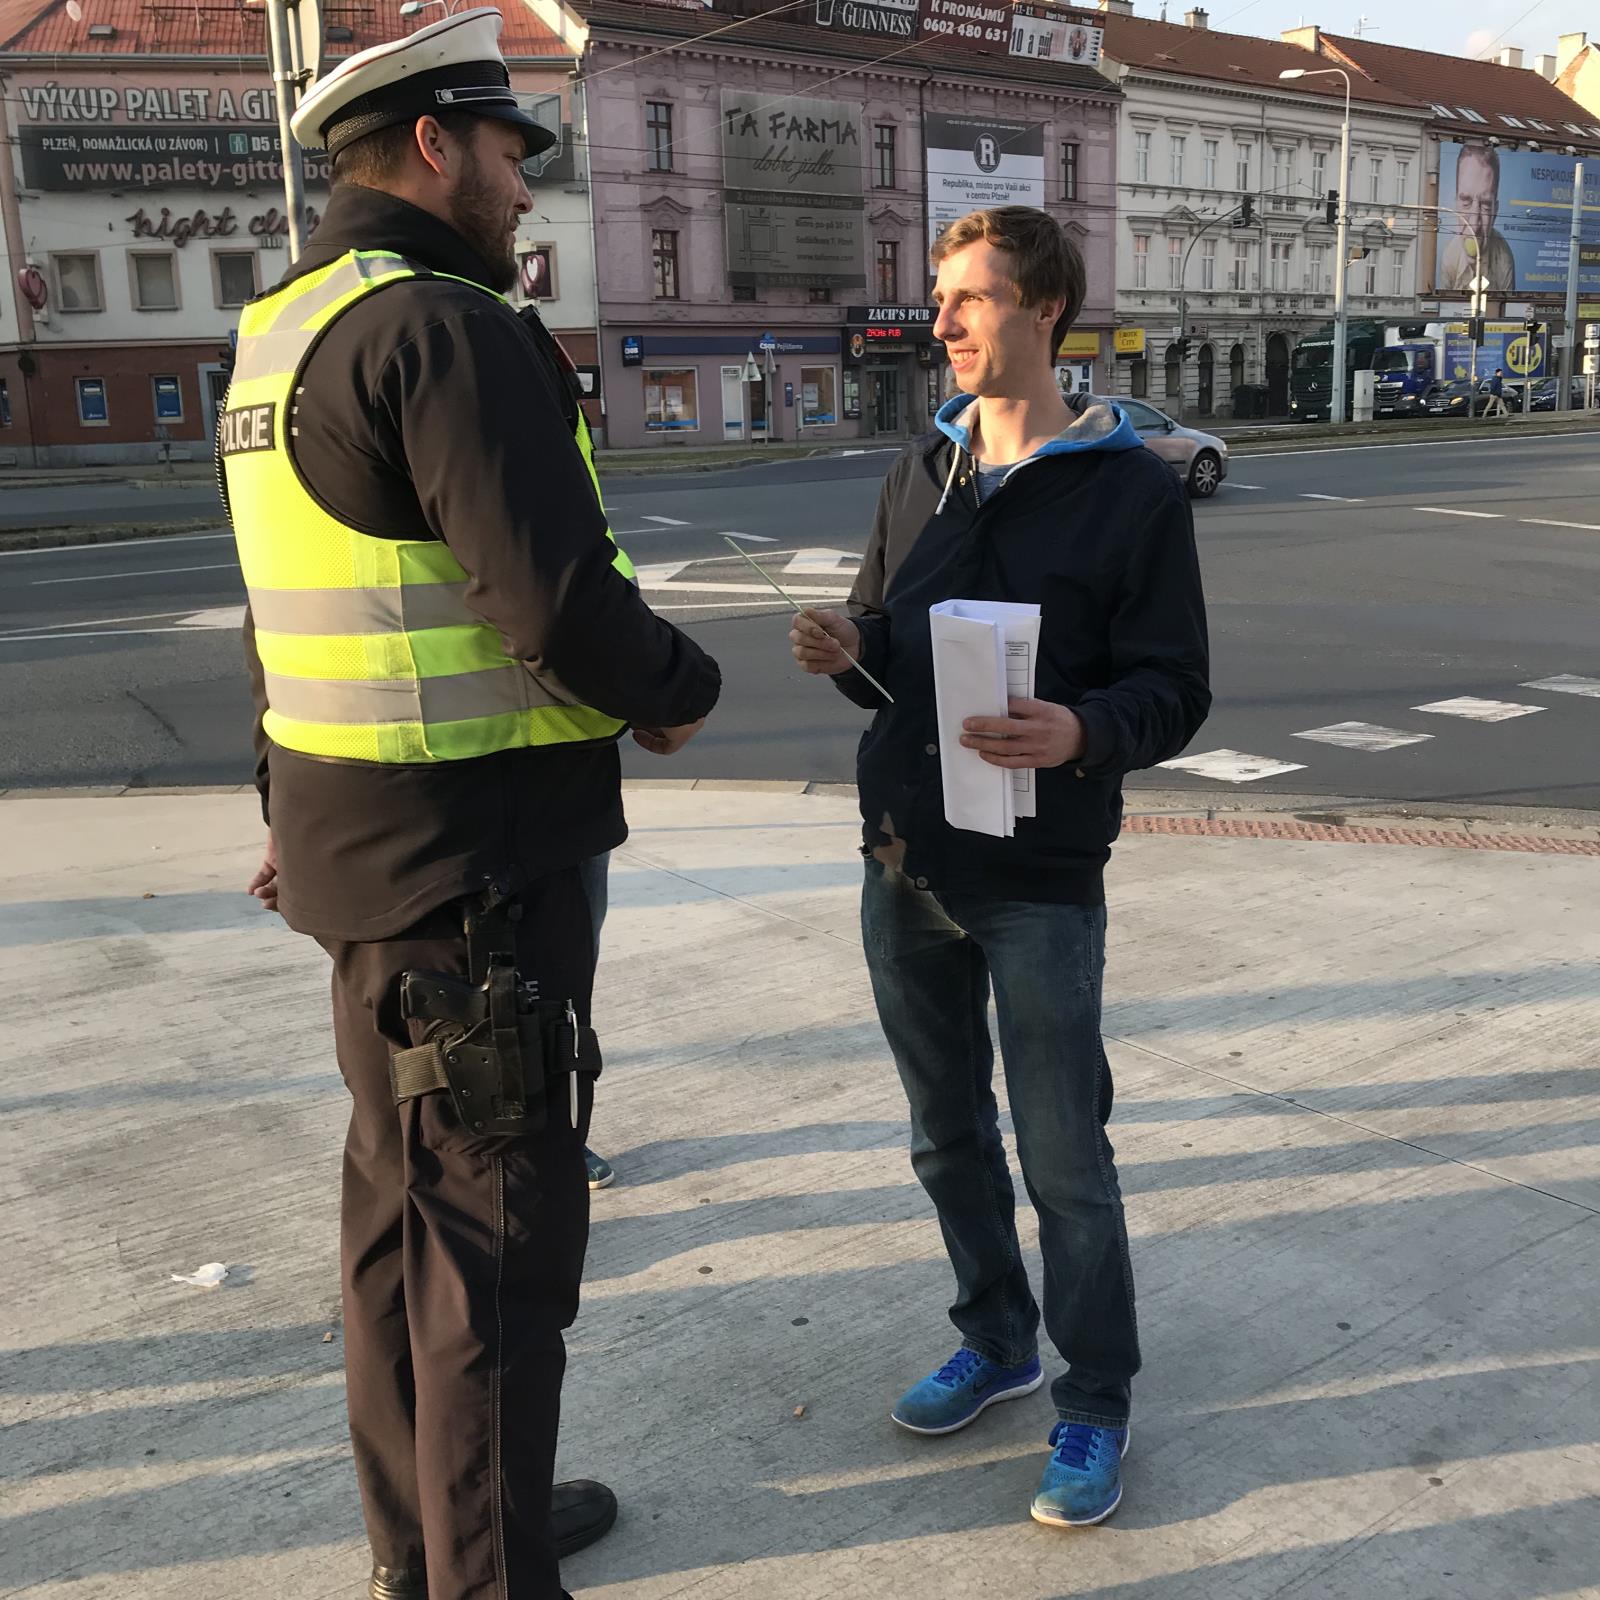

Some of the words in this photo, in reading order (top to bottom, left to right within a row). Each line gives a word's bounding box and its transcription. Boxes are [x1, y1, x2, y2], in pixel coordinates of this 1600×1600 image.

[842, 2, 912, 35] GUINNESS
[930, 0, 941, 13] K
[942, 2, 1005, 23] PRONÁJMU
[923, 18, 954, 34] 0602
[958, 24, 982, 39] 480
[985, 27, 1008, 42] 631
[1011, 28, 1024, 52] 10
[1027, 34, 1035, 54] a
[20, 81, 118, 121] VÝKUP
[125, 88, 209, 121] PALET
[217, 88, 238, 121] A
[242, 88, 278, 121] GI
[725, 107, 759, 138] TA
[769, 111, 858, 145] FARMA
[42, 136, 80, 152] PLZEŇ,
[83, 135, 153, 151] DOMAŽLICKÁ
[155, 137, 167, 152] (U
[169, 136, 208, 152] ZÁVOR)
[252, 136, 270, 151] D5
[979, 138, 996, 166] R
[753, 145, 797, 173] dobré
[868, 308, 905, 321] ZACH'S
[907, 308, 930, 321] PUB
[888, 328, 902, 337] PUB
